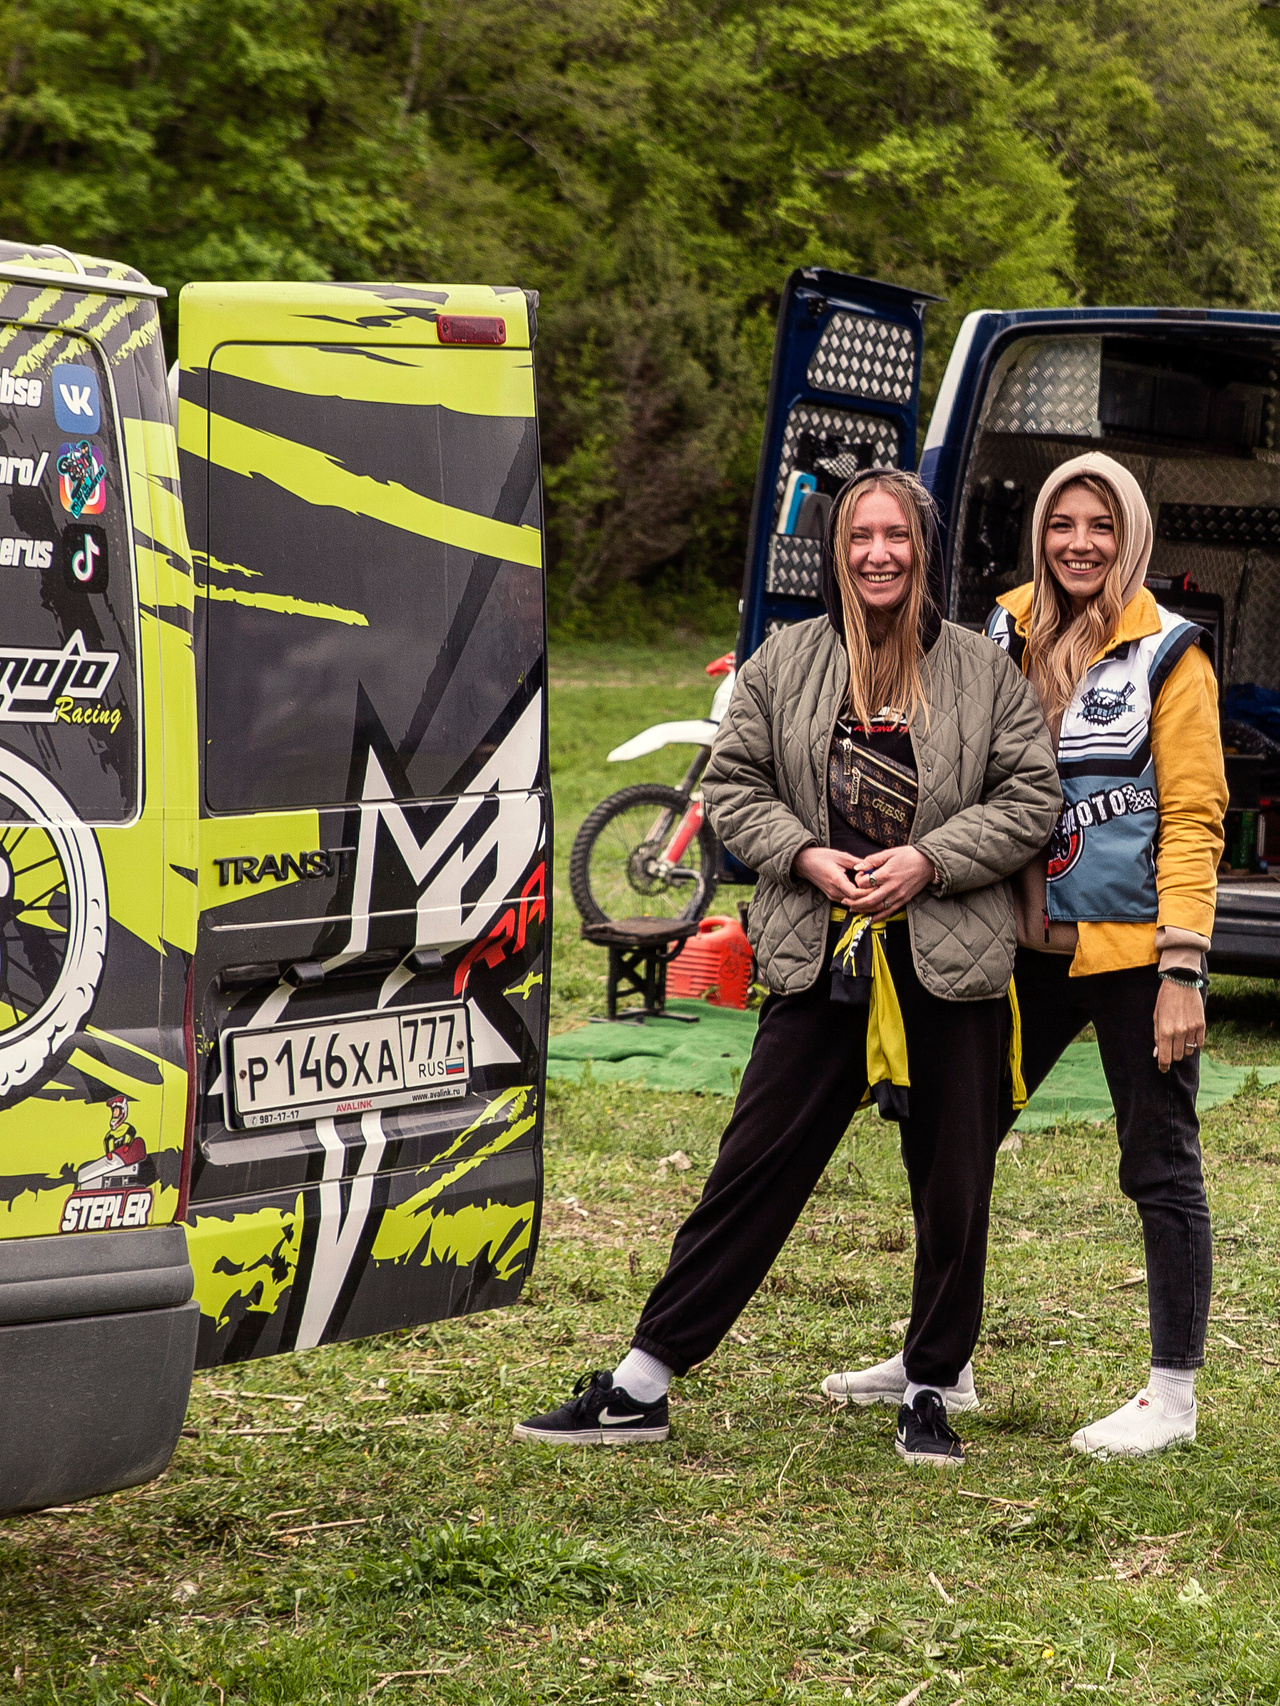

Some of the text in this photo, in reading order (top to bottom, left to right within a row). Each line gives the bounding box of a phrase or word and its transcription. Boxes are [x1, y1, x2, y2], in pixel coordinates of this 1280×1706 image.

[55, 696, 123, 734] Racing
[872, 798, 906, 823] GUESS
[402, 1014, 455, 1062] 777
[418, 1060, 444, 1078] RUS
[259, 1088, 461, 1124] 987-17-17 AVALINK www.avalink.ru
[61, 1192, 151, 1232] STEPLER
